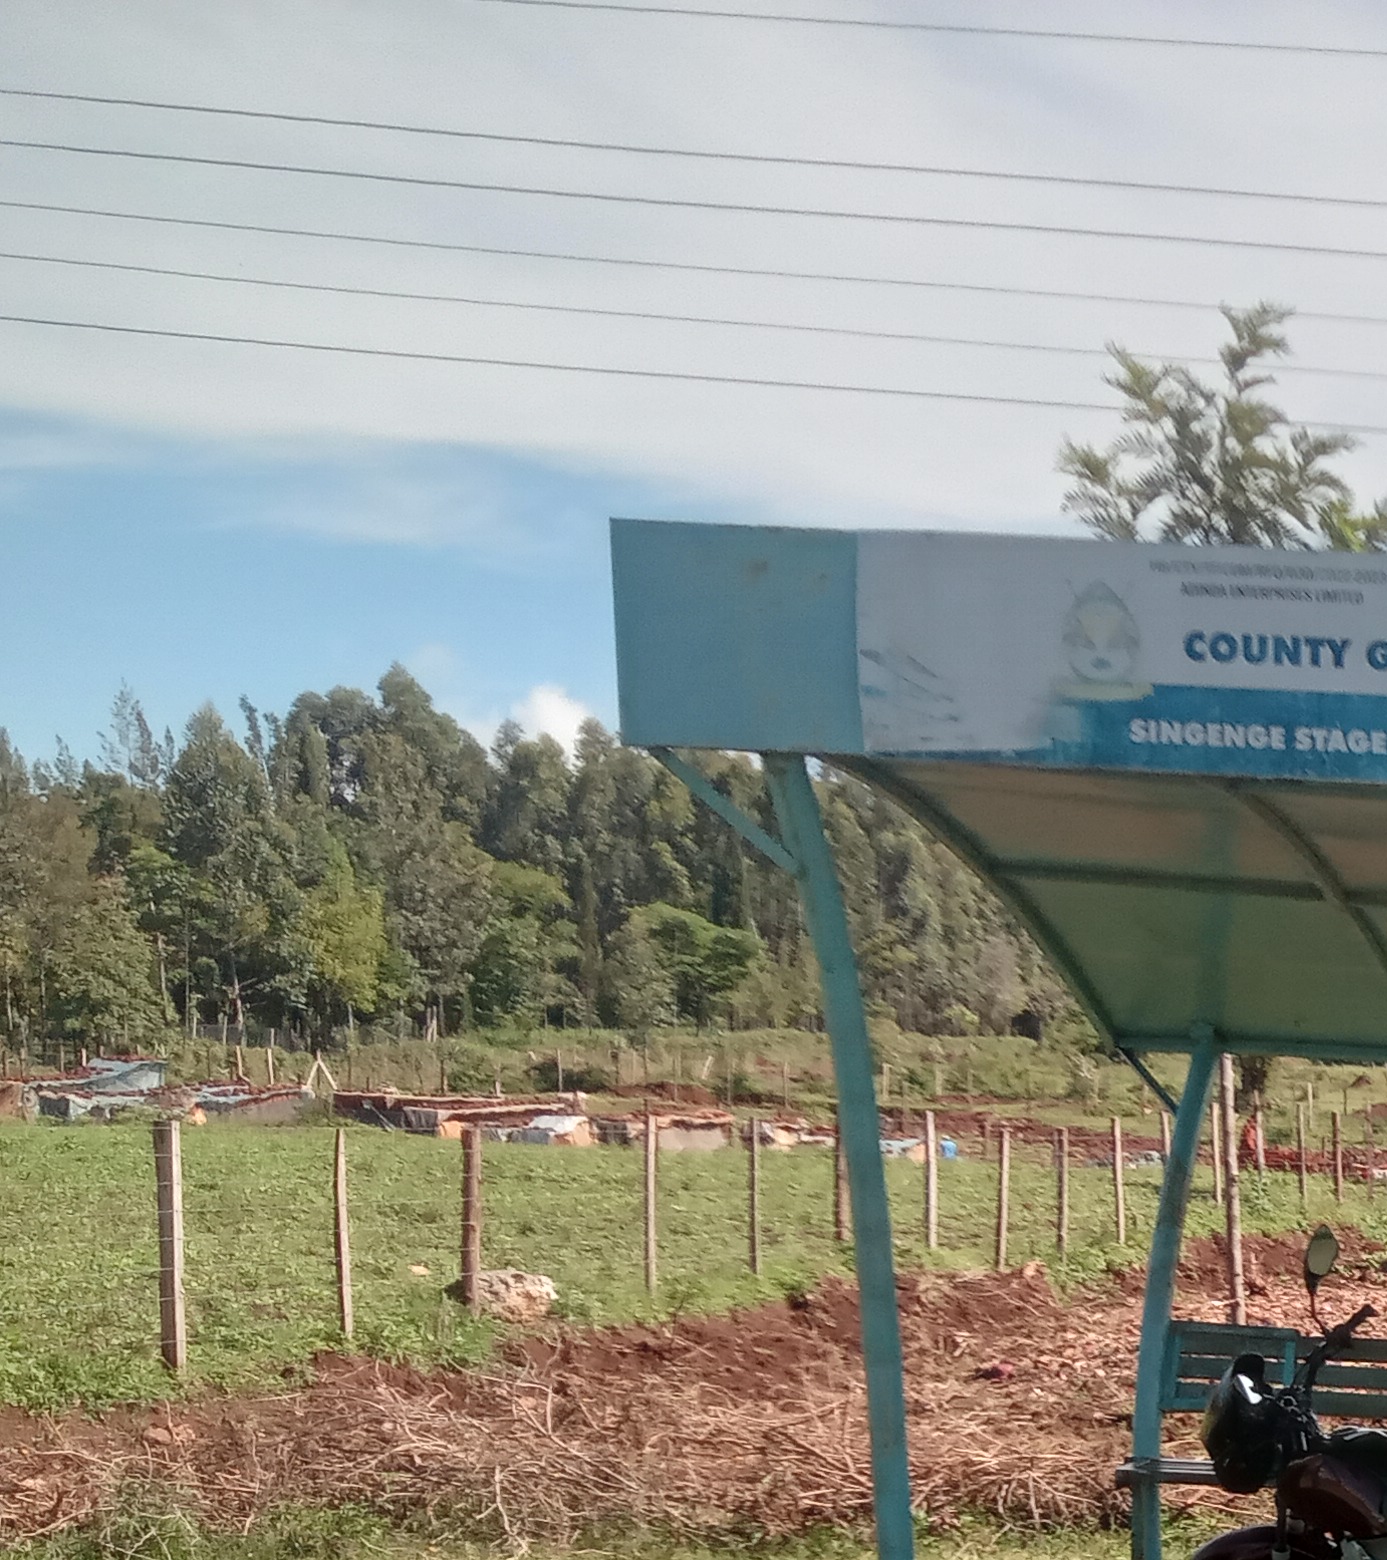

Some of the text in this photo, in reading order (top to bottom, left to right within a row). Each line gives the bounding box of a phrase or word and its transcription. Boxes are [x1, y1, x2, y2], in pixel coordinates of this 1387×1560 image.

[1183, 630, 1351, 669] COUNTY
[1129, 718, 1286, 751] SINGENGE
[1295, 726, 1387, 756] STAGE
